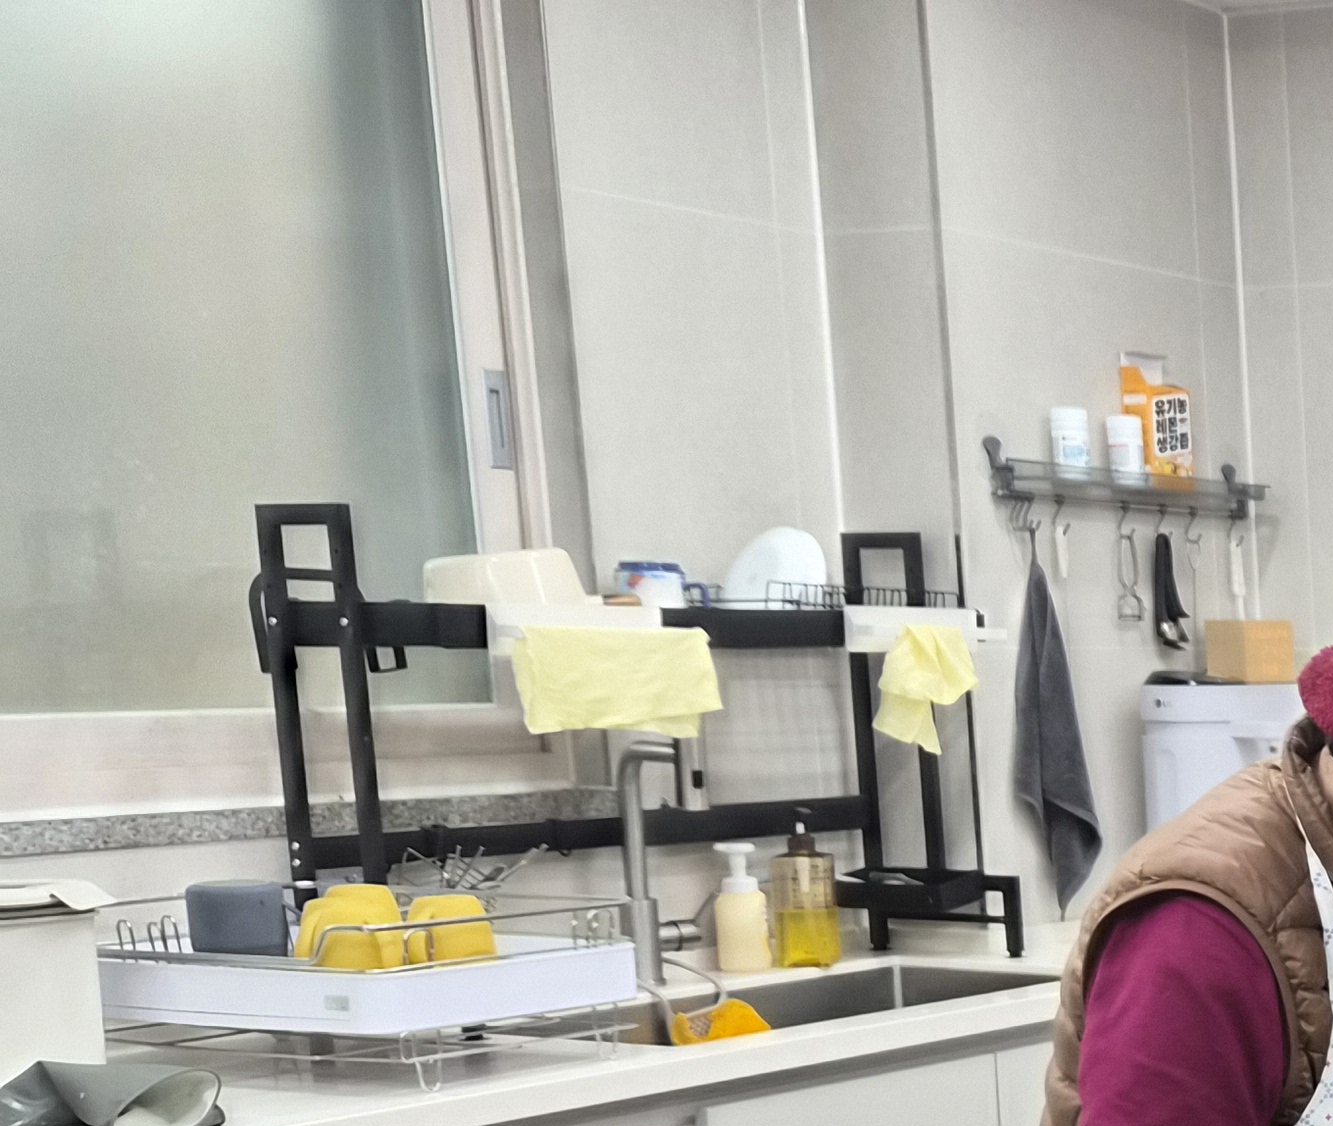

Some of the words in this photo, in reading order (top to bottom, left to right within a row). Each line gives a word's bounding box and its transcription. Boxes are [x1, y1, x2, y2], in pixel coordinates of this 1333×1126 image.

[1154, 397, 1188, 418] 유기농
[1156, 416, 1178, 435] 레몬
[1157, 432, 1189, 454] 생강즙
